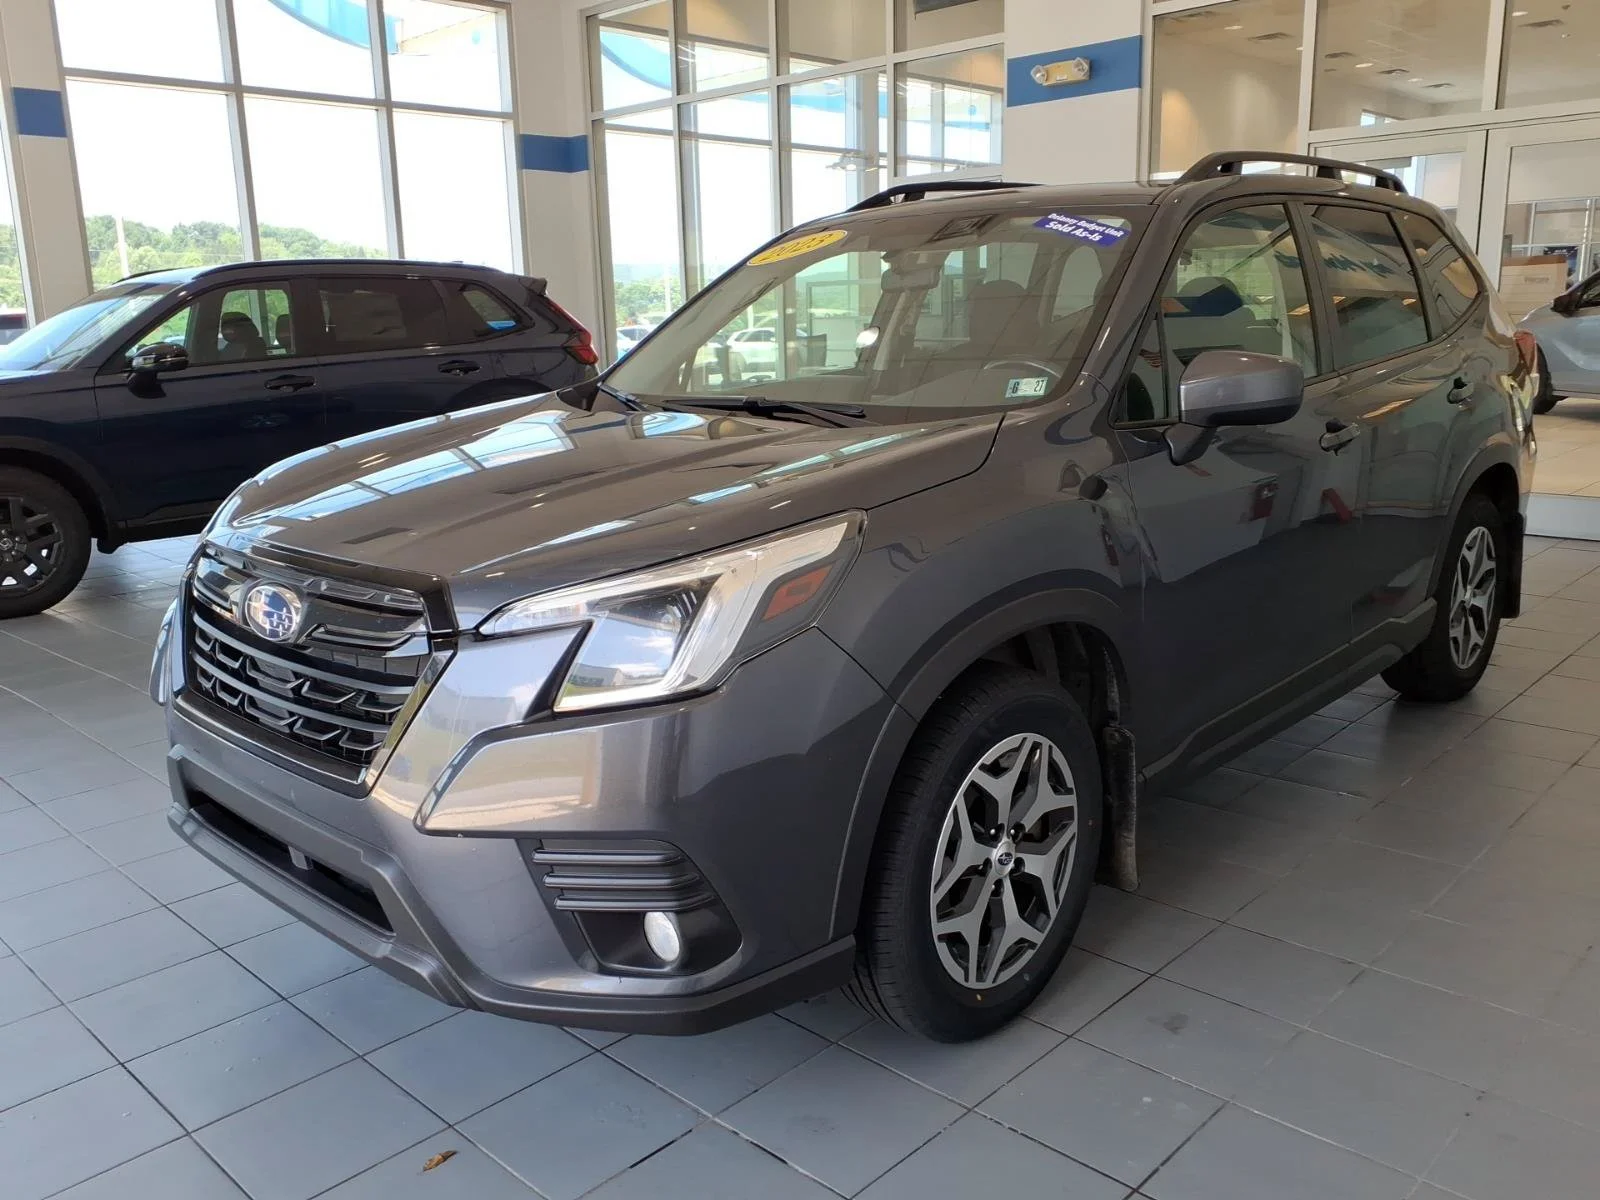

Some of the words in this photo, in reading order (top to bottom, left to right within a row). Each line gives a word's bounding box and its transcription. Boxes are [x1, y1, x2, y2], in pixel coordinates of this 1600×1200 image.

[1045, 221, 1076, 233] Sold
[1076, 220, 1107, 232] Budget
[1104, 228, 1125, 238] Unit
[1033, 379, 1045, 393] 27
